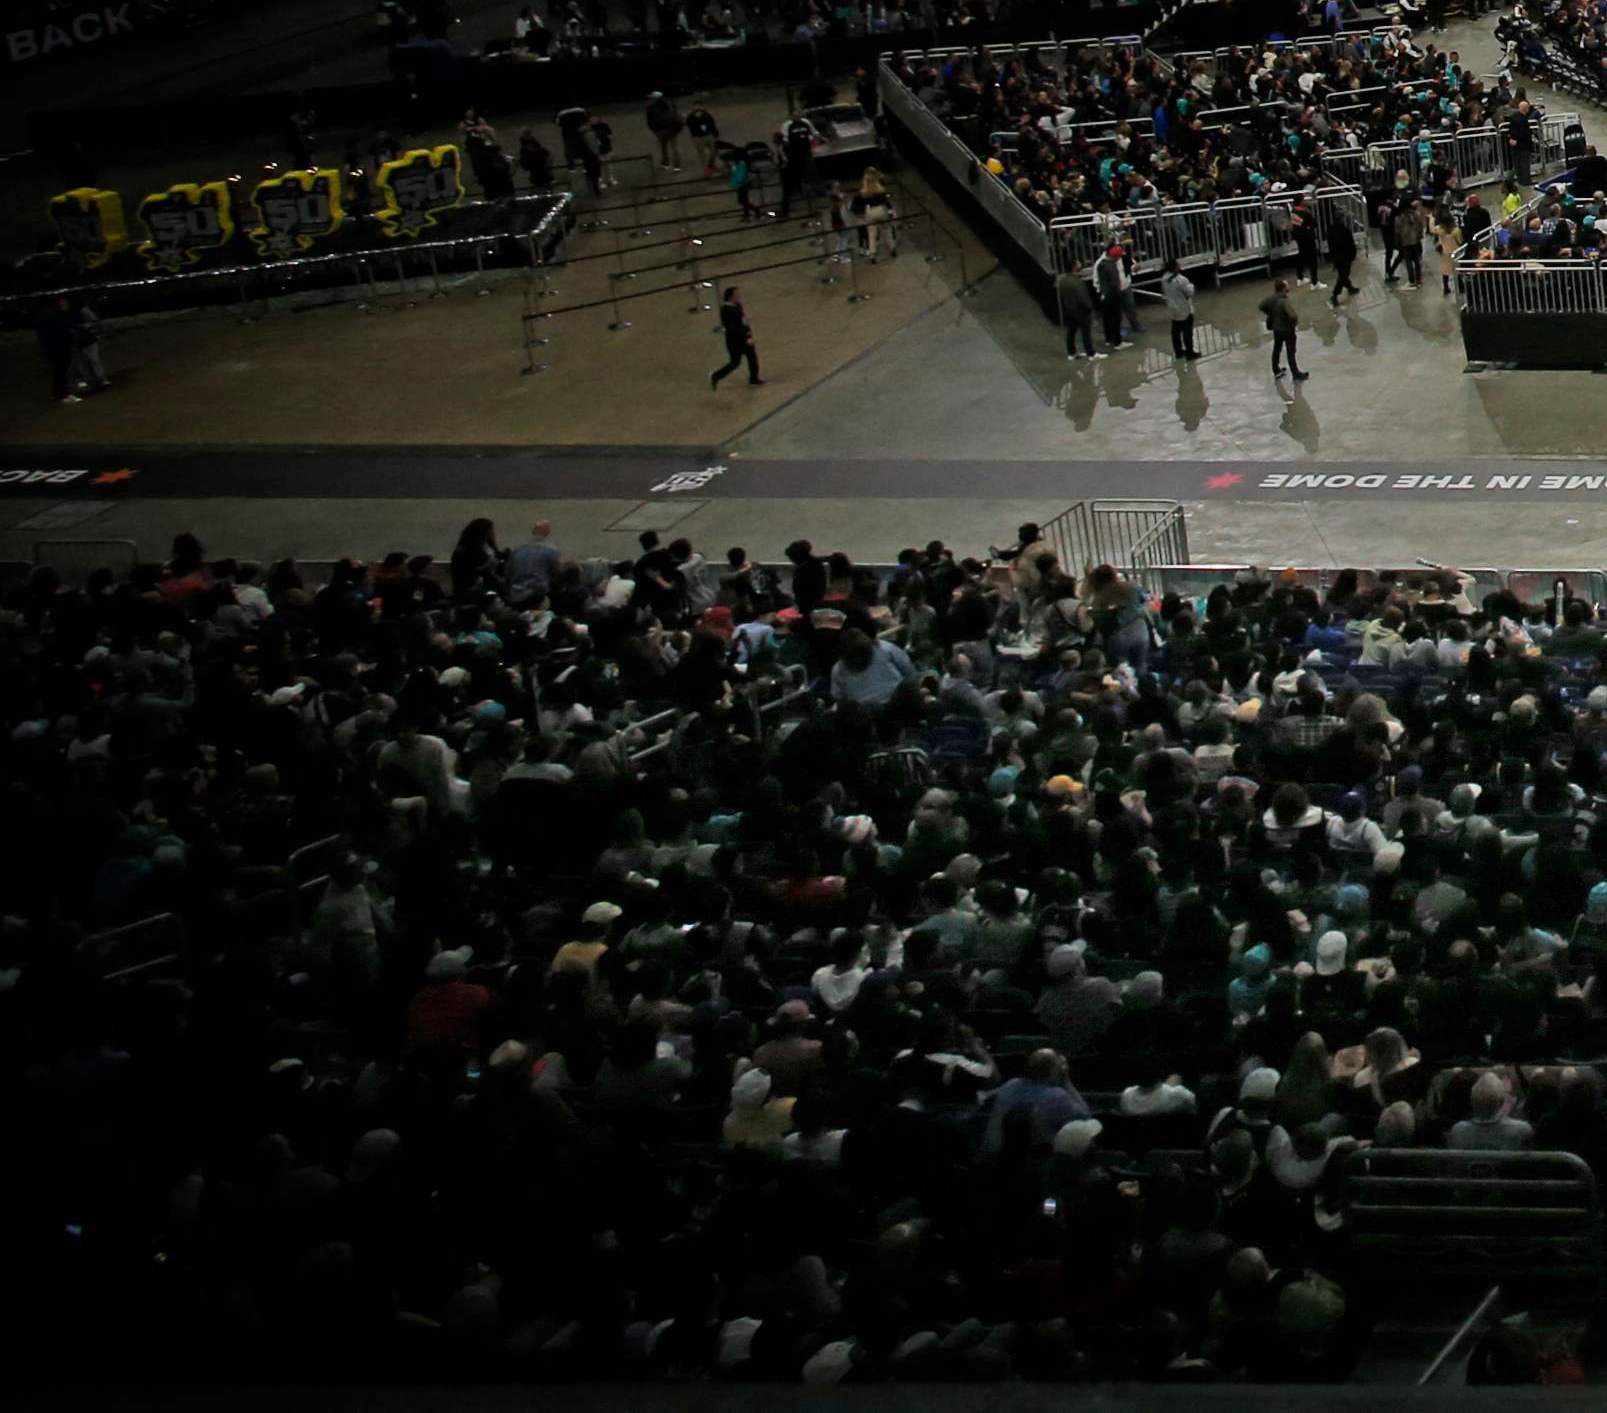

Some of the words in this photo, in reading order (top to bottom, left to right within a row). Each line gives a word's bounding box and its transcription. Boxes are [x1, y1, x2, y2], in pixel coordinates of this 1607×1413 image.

[5, 3, 135, 64] BACK
[1259, 472, 1384, 488] DOME
[1393, 473, 1475, 489] THE
[1487, 473, 1531, 489] IN
